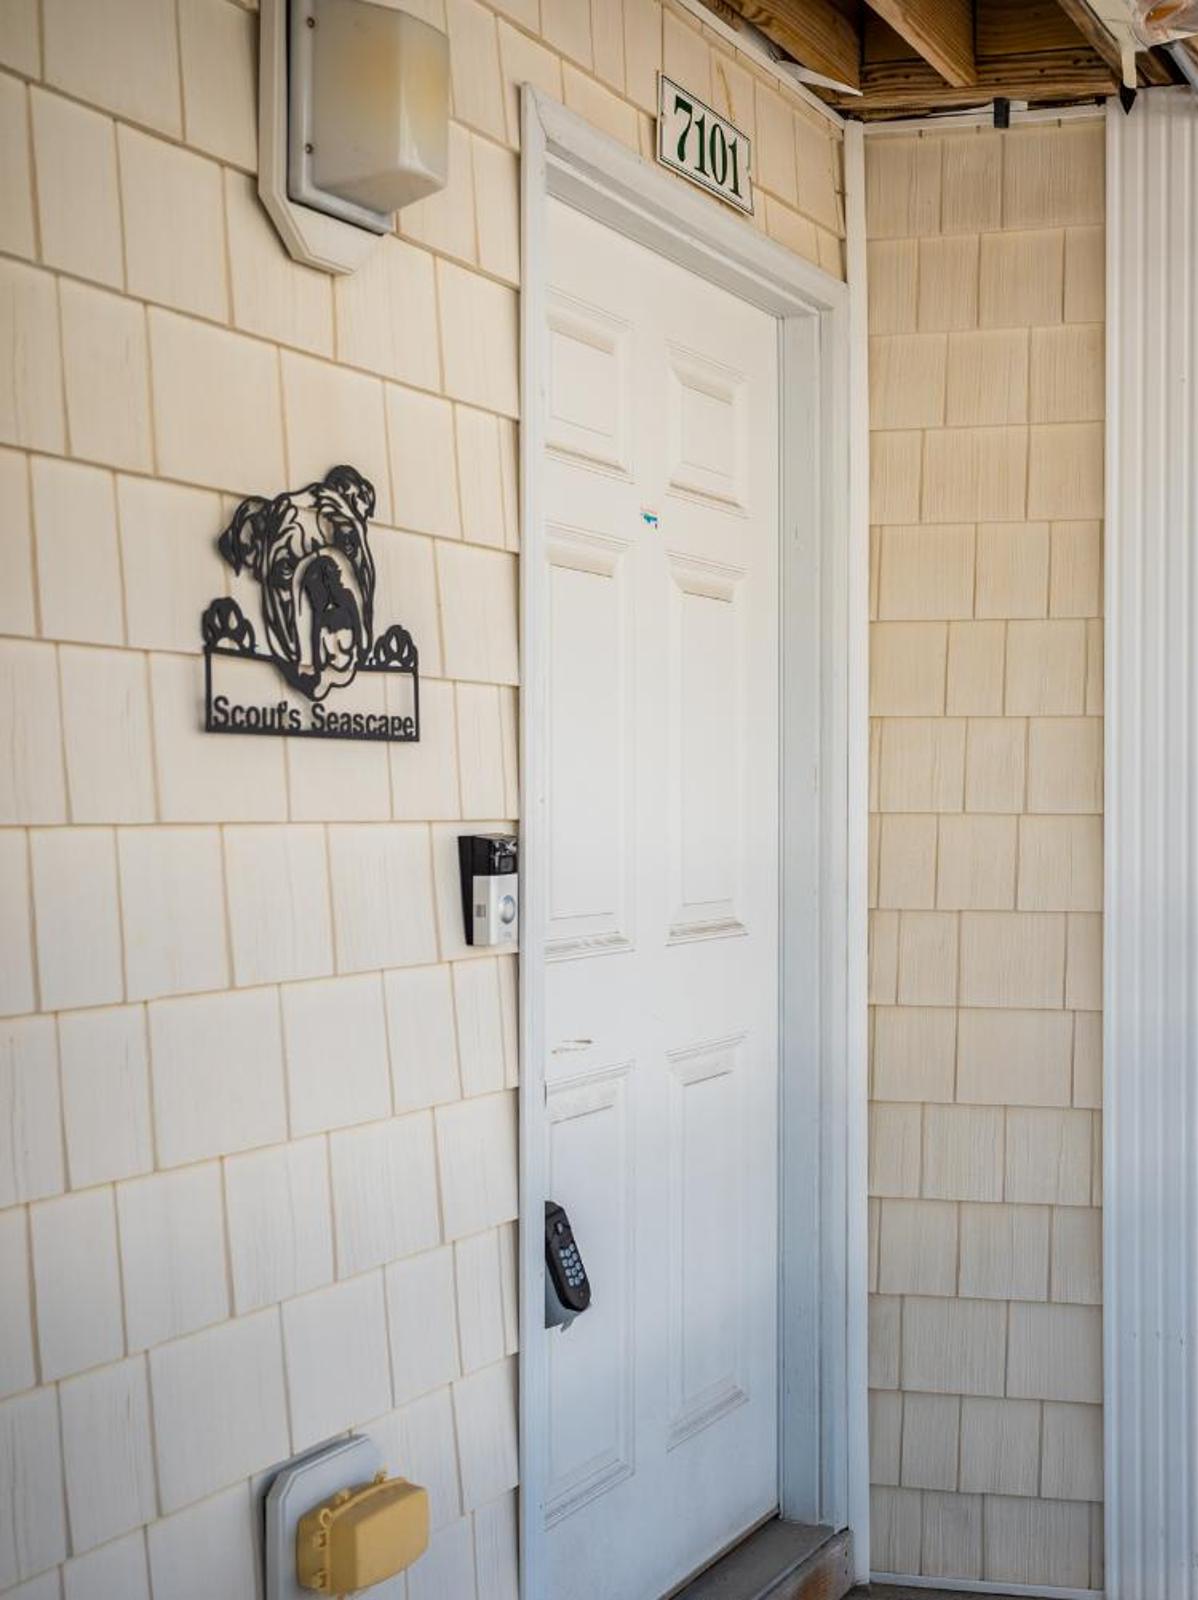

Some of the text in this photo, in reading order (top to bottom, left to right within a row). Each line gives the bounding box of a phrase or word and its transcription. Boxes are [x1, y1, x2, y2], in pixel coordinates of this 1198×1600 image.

[674, 95, 742, 198] 7101
[212, 695, 415, 736] Scout's Seascape
